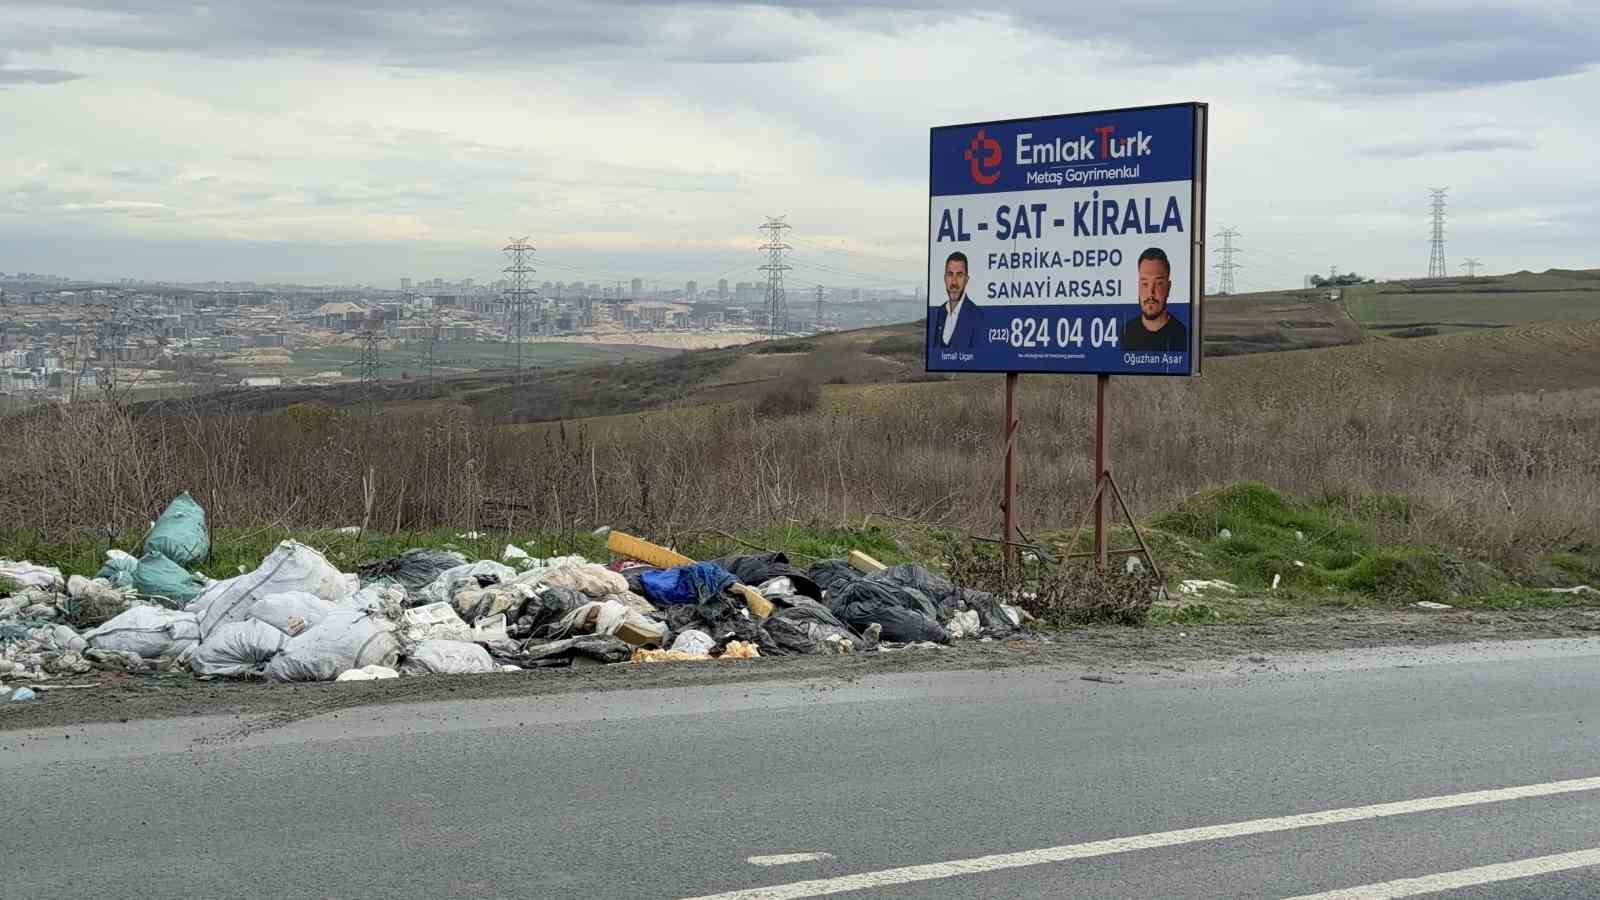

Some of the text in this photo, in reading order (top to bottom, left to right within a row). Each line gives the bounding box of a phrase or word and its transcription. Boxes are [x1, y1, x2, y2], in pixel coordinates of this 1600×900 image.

[1016, 126, 1153, 165] Emlak Türk
[1026, 164, 1140, 185] Metaş Gayrimenkul
[937, 208, 971, 243] AL
[995, 202, 1048, 241] SAT
[1073, 190, 1185, 238] KİRALA
[987, 247, 1123, 270] FABRİKA-DEPO
[987, 276, 1122, 299] SANAYİ ARSASI
[988, 317, 1119, 348] (212) 824 04 04
[1123, 352, 1160, 366] Oğuzhan
